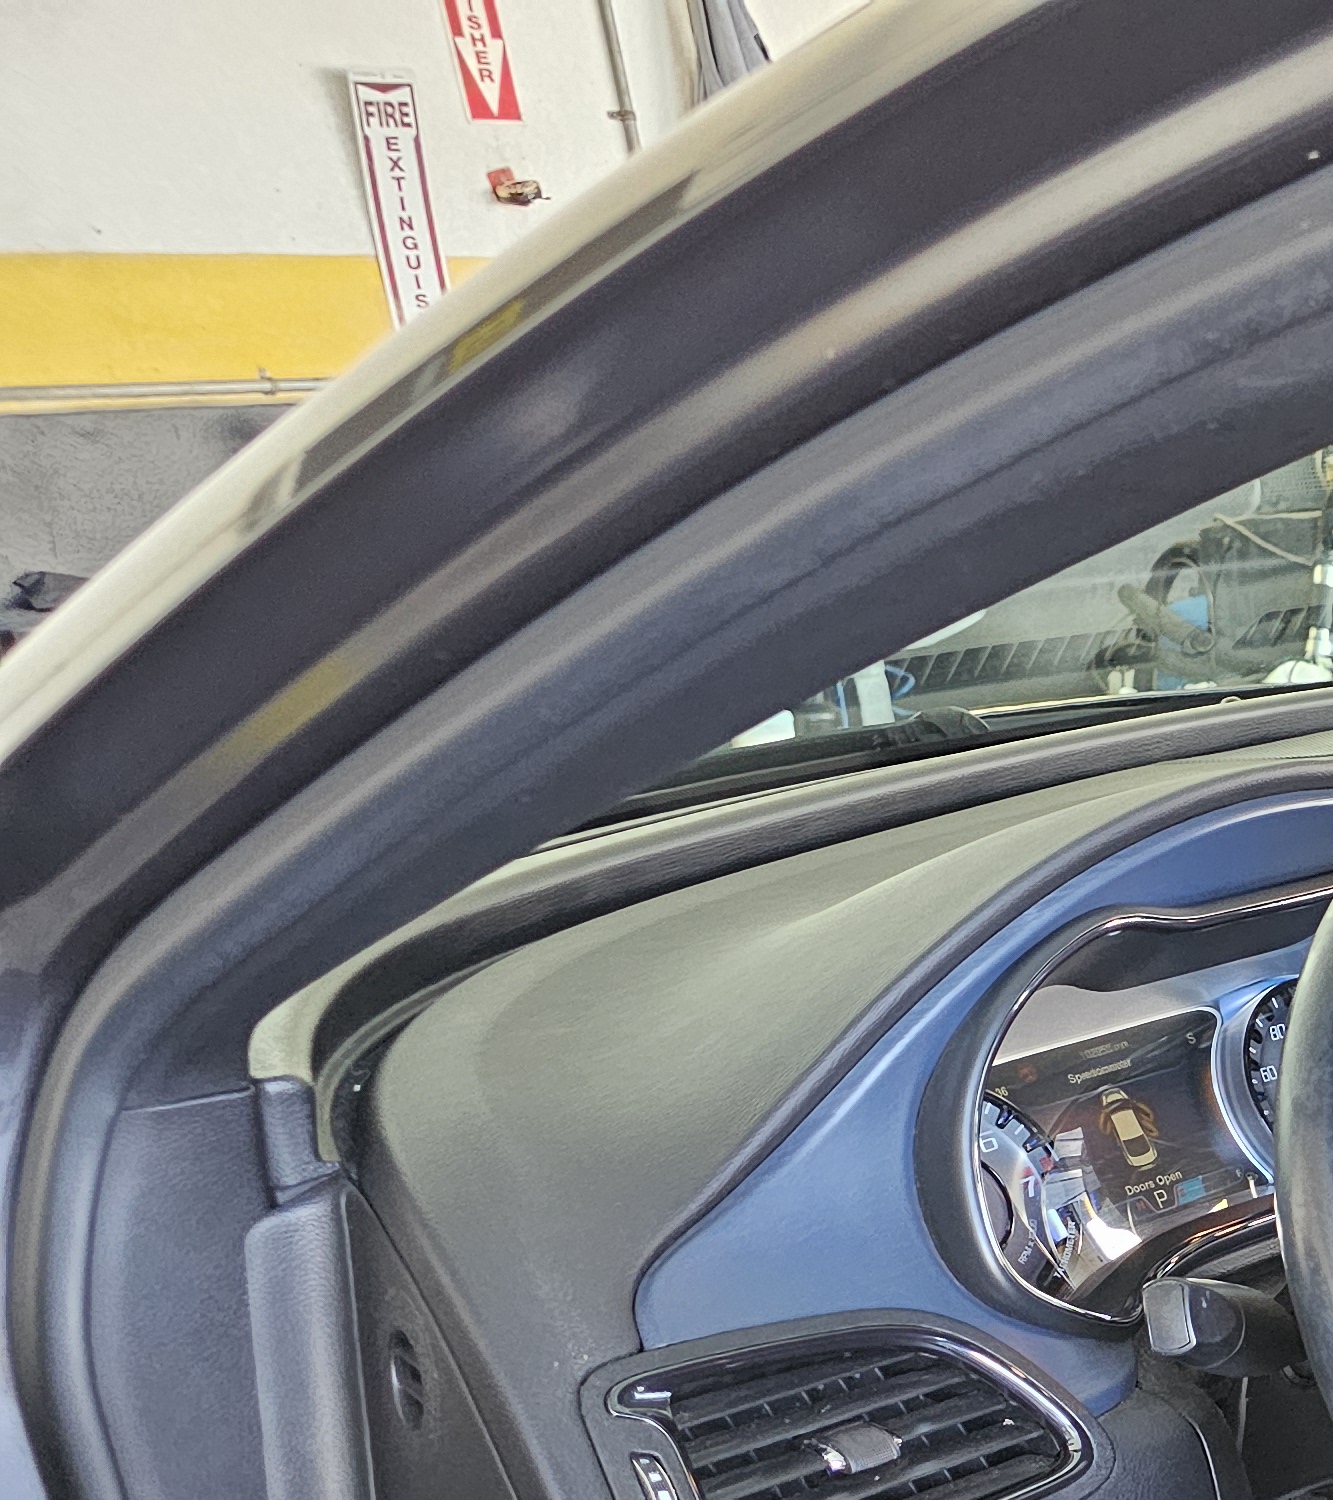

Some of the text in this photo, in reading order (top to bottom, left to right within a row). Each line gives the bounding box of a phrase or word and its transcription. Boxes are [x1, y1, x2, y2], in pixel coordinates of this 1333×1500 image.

[363, 101, 413, 128] FIRE
[1260, 1065, 1277, 1083] 60
[1020, 1175, 1036, 1198] 7
[1125, 1170, 1183, 1196] Doors Open
[1153, 1189, 1168, 1209] P
